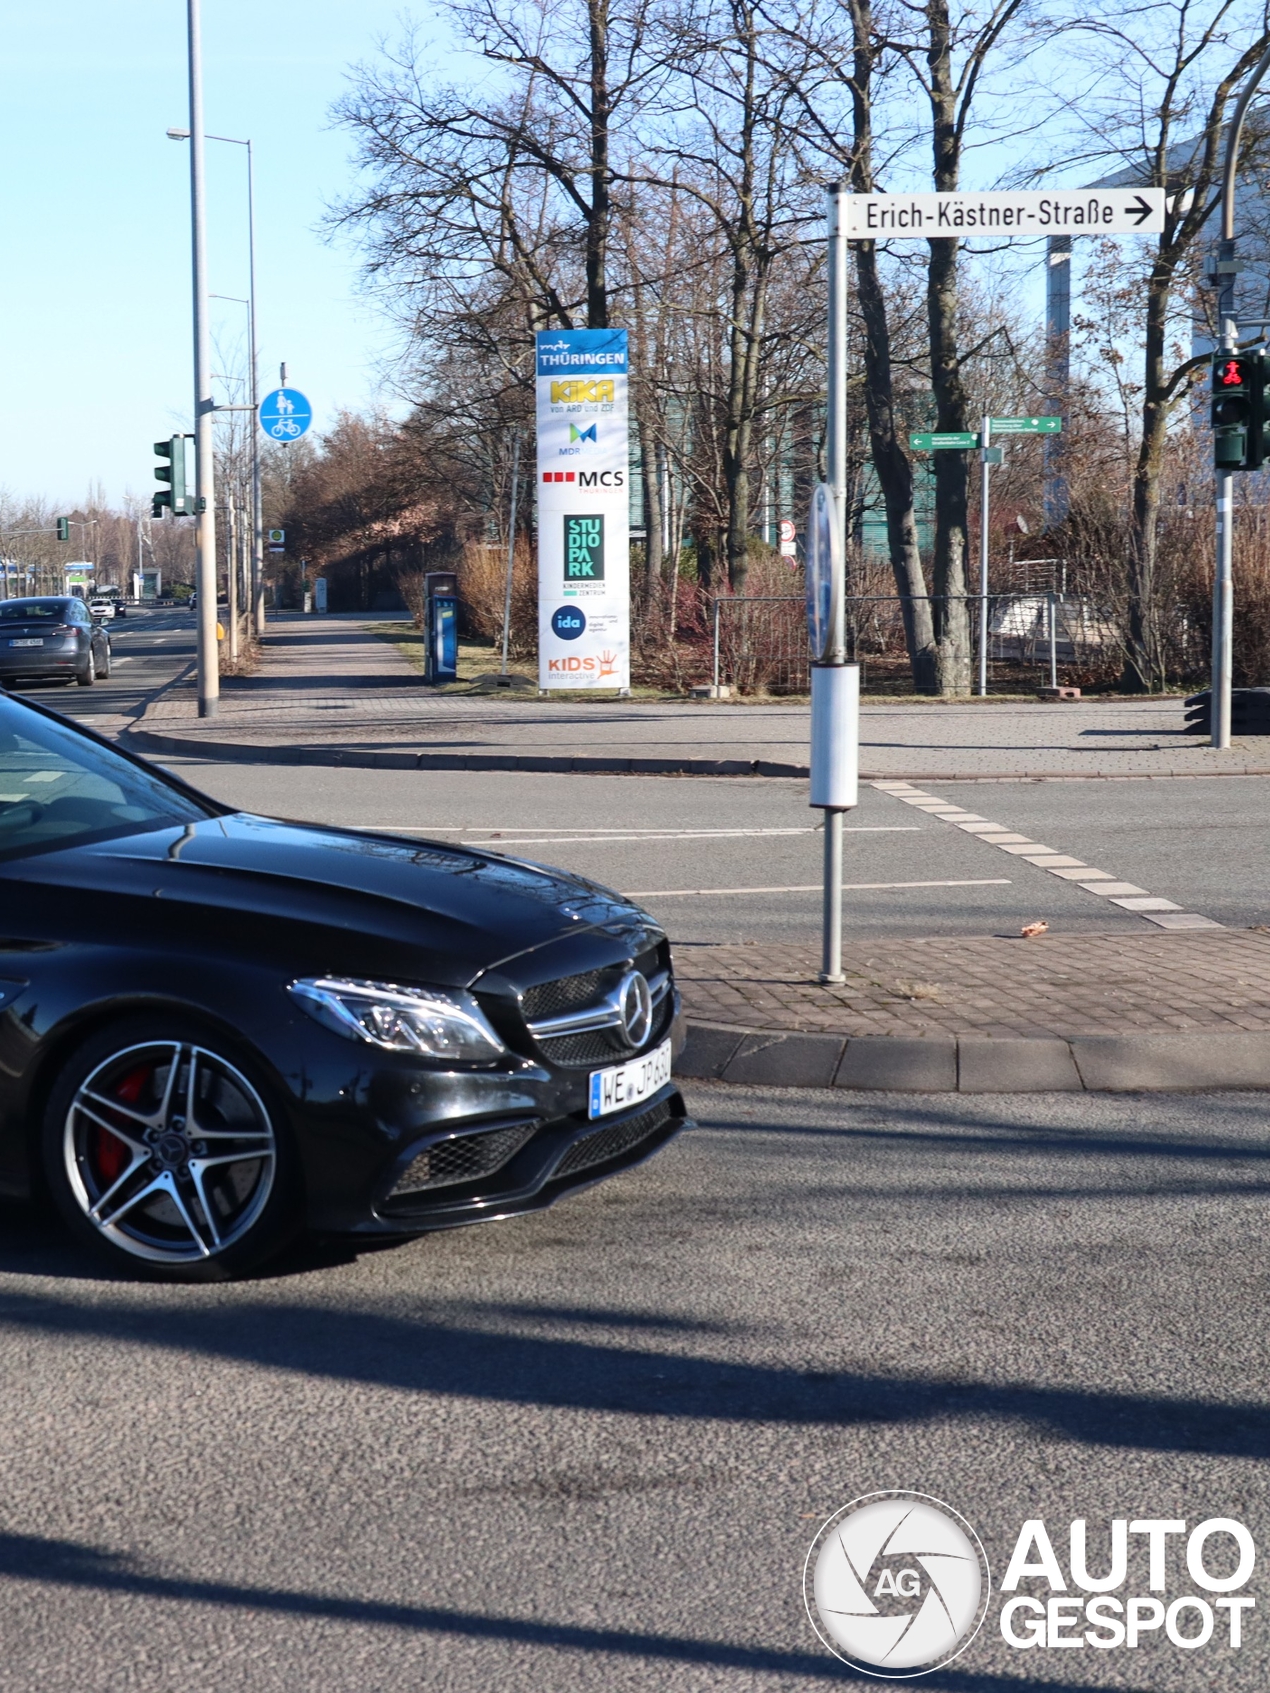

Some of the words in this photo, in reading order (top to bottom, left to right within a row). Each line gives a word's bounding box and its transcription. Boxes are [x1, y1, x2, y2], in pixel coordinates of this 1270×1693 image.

[866, 198, 1114, 229] Erich-Kästner-Straße
[539, 340, 570, 351] mdr
[540, 352, 625, 366] THÜRINGEN
[566, 404, 582, 412] ARD
[601, 403, 614, 412] ZDF
[578, 471, 624, 487] MCS
[569, 519, 600, 534] STU
[569, 533, 600, 548] DIO
[568, 561, 595, 576] RK
[557, 615, 581, 628] ida
[548, 656, 595, 672] KIDS
[548, 672, 595, 680] interactive
[603, 1071, 626, 1108] WE
